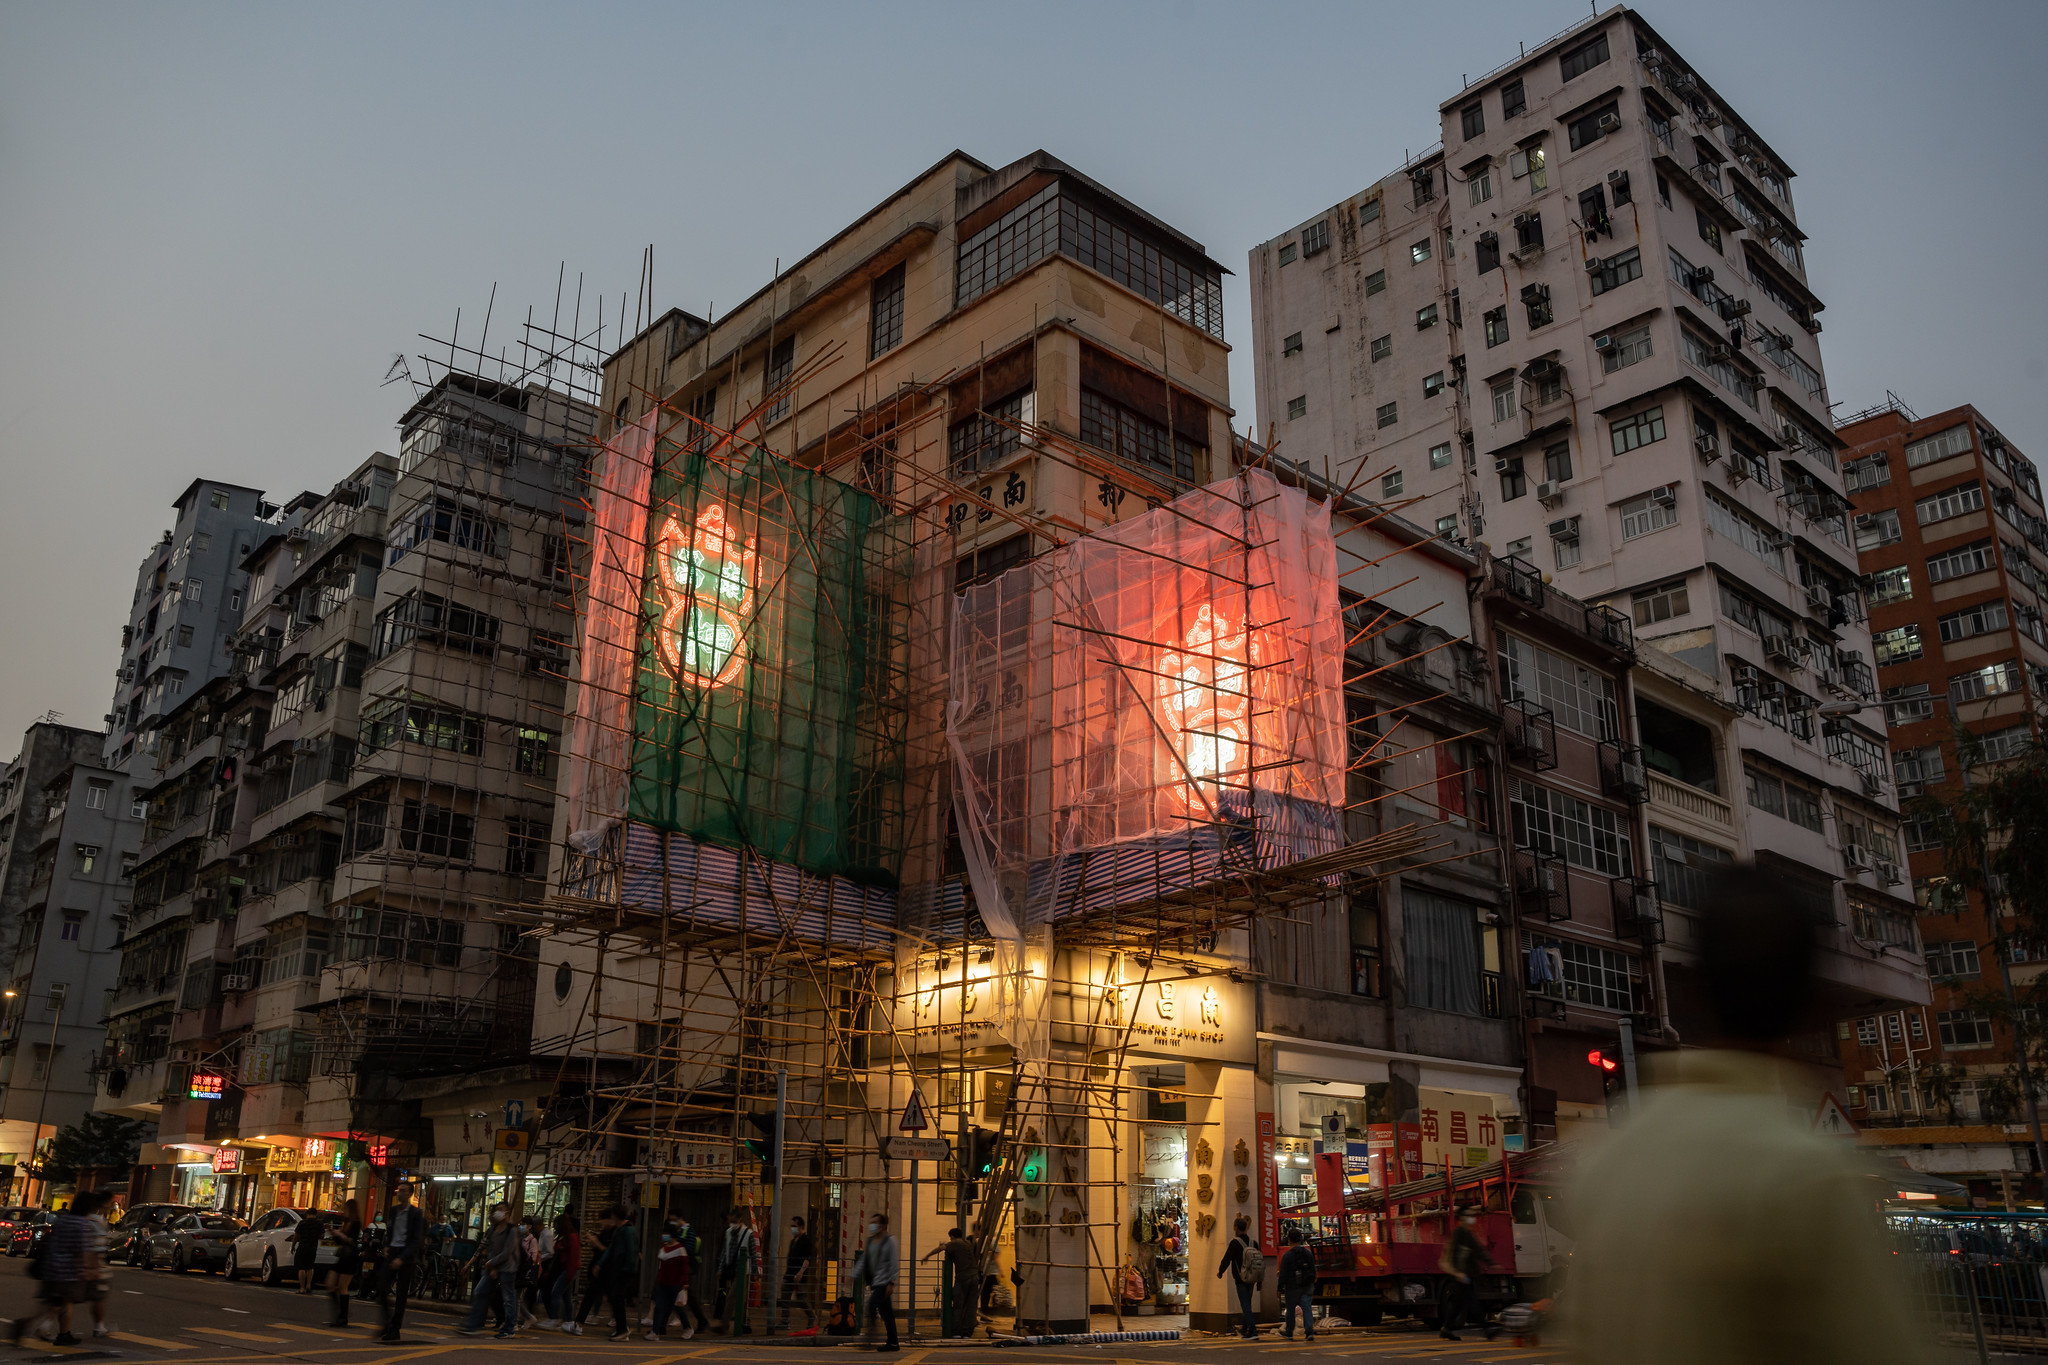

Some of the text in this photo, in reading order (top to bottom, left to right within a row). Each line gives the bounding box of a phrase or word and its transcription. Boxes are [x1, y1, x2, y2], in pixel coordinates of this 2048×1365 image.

[1201, 1031, 1224, 1044] SHOP
[1421, 1107, 1496, 1147] 南昌市
[907, 1140, 926, 1148] Cheong
[514, 1165, 524, 1173] 12
[1195, 1138, 1216, 1238] 南昌押
[1262, 1141, 1275, 1248] NIPPON PAINT
